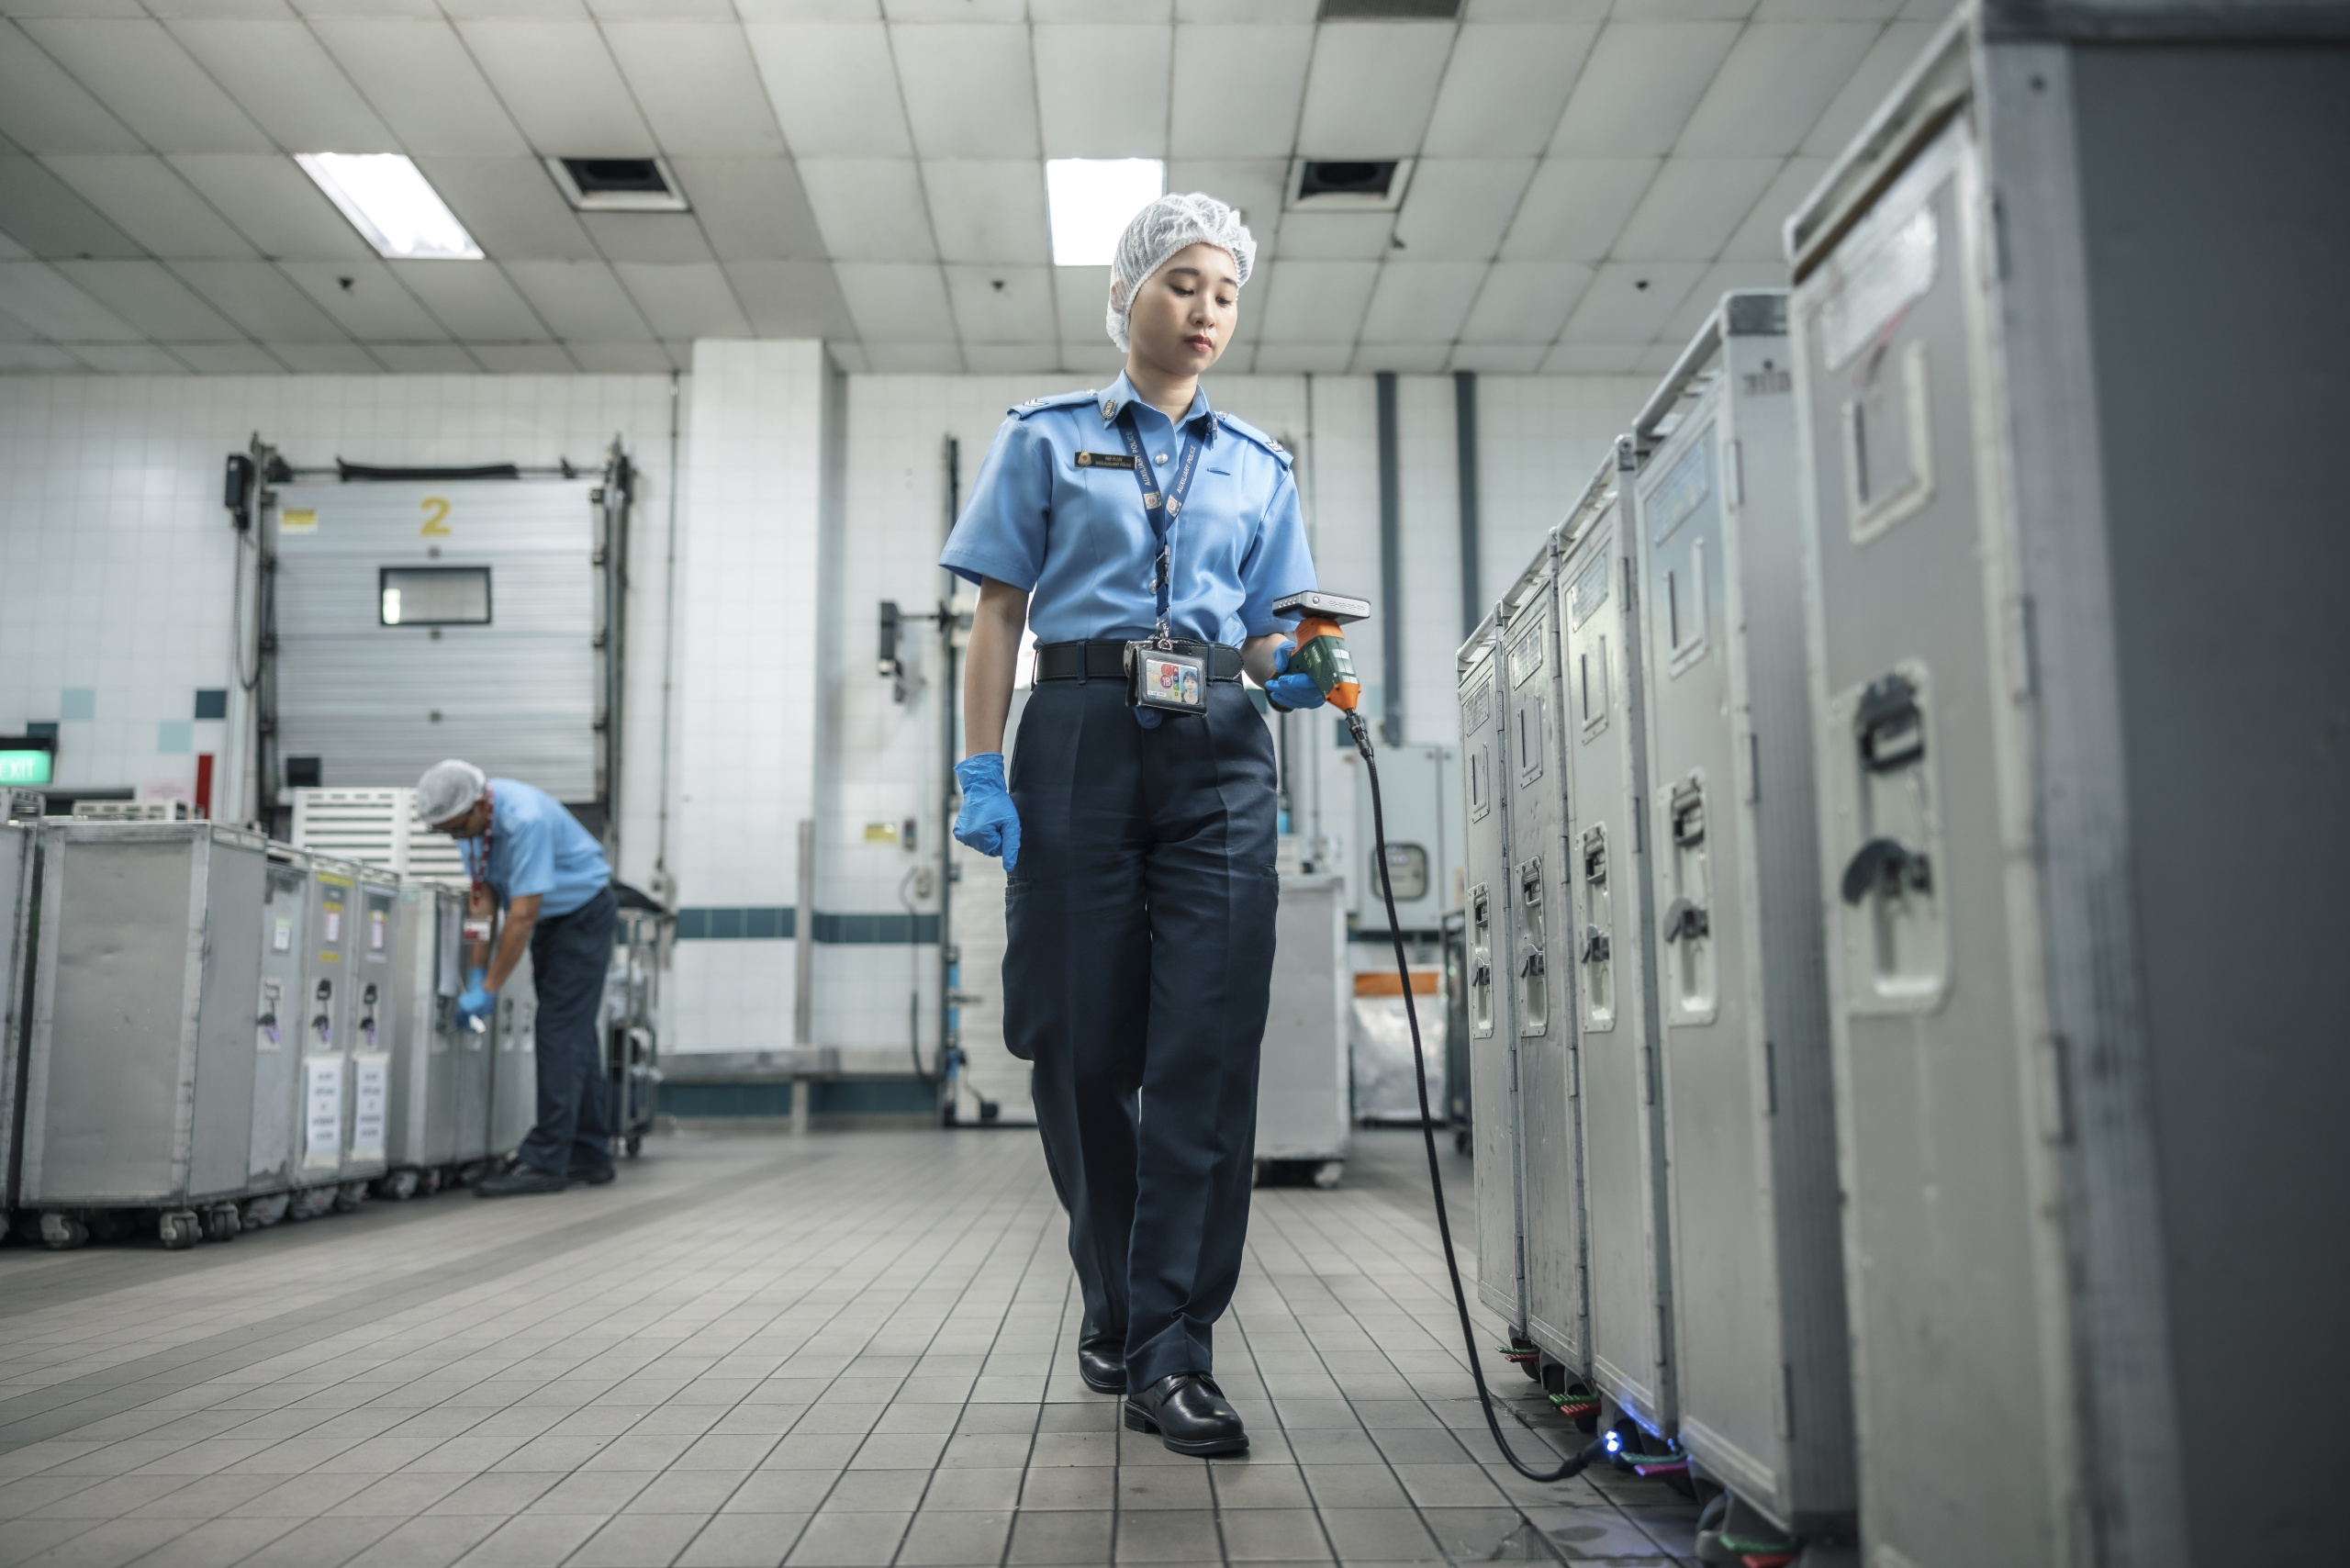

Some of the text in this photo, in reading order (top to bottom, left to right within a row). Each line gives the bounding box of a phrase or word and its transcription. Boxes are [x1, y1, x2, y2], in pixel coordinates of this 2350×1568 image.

[1125, 431, 1151, 487] AUXILIARY POLICE
[1176, 444, 1196, 495] AUXILIARY POLICE
[420, 496, 452, 537] 2
[1162, 677, 1171, 687] 1B
[0, 758, 35, 780] EXIT
